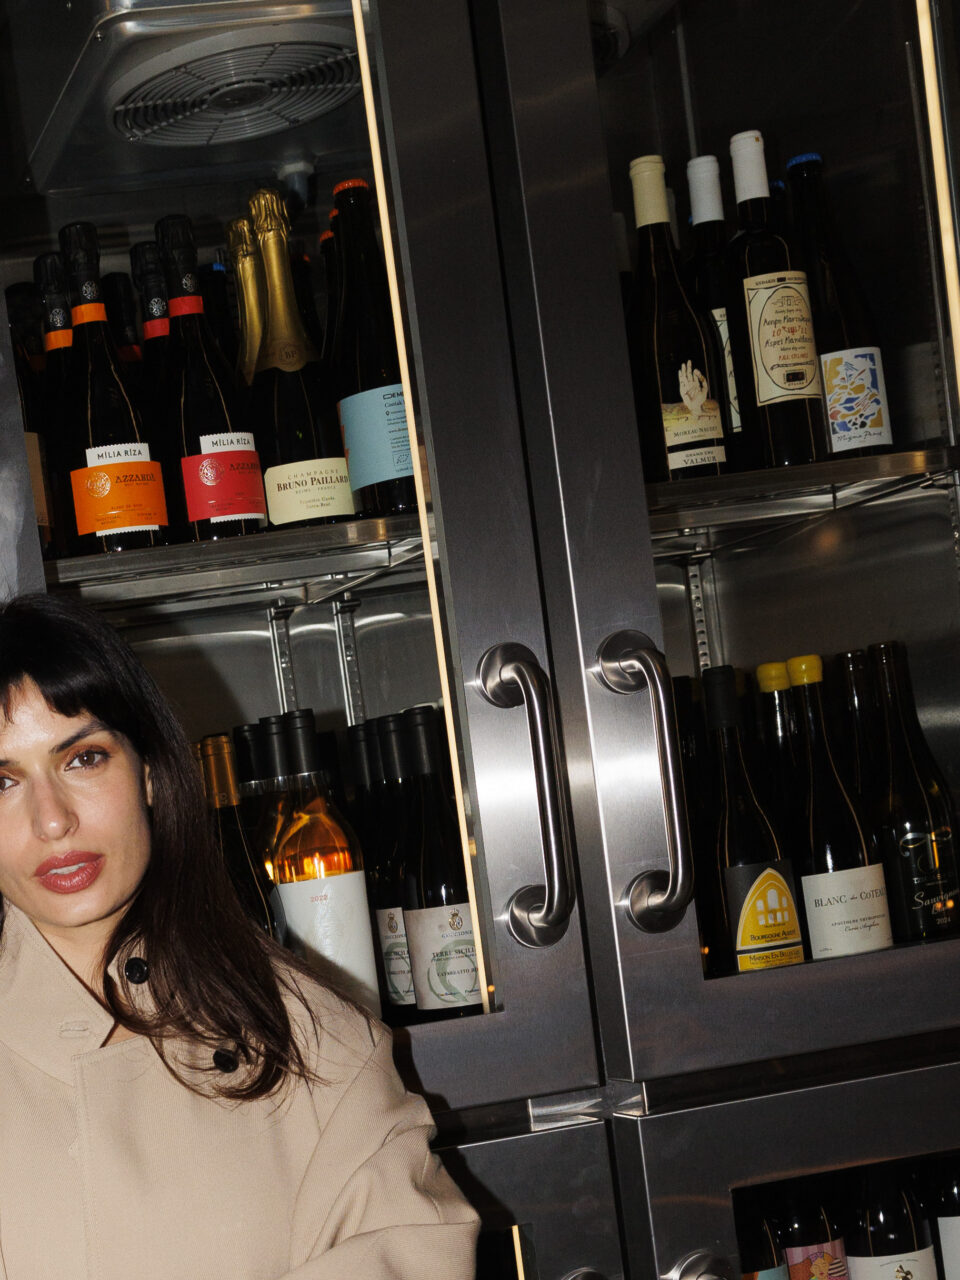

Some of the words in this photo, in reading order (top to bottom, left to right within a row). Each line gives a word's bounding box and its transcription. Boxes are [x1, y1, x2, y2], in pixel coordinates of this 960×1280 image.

[276, 479, 308, 492] BRUNO
[310, 475, 349, 486] PAILLARD
[814, 894, 848, 908] BLANC
